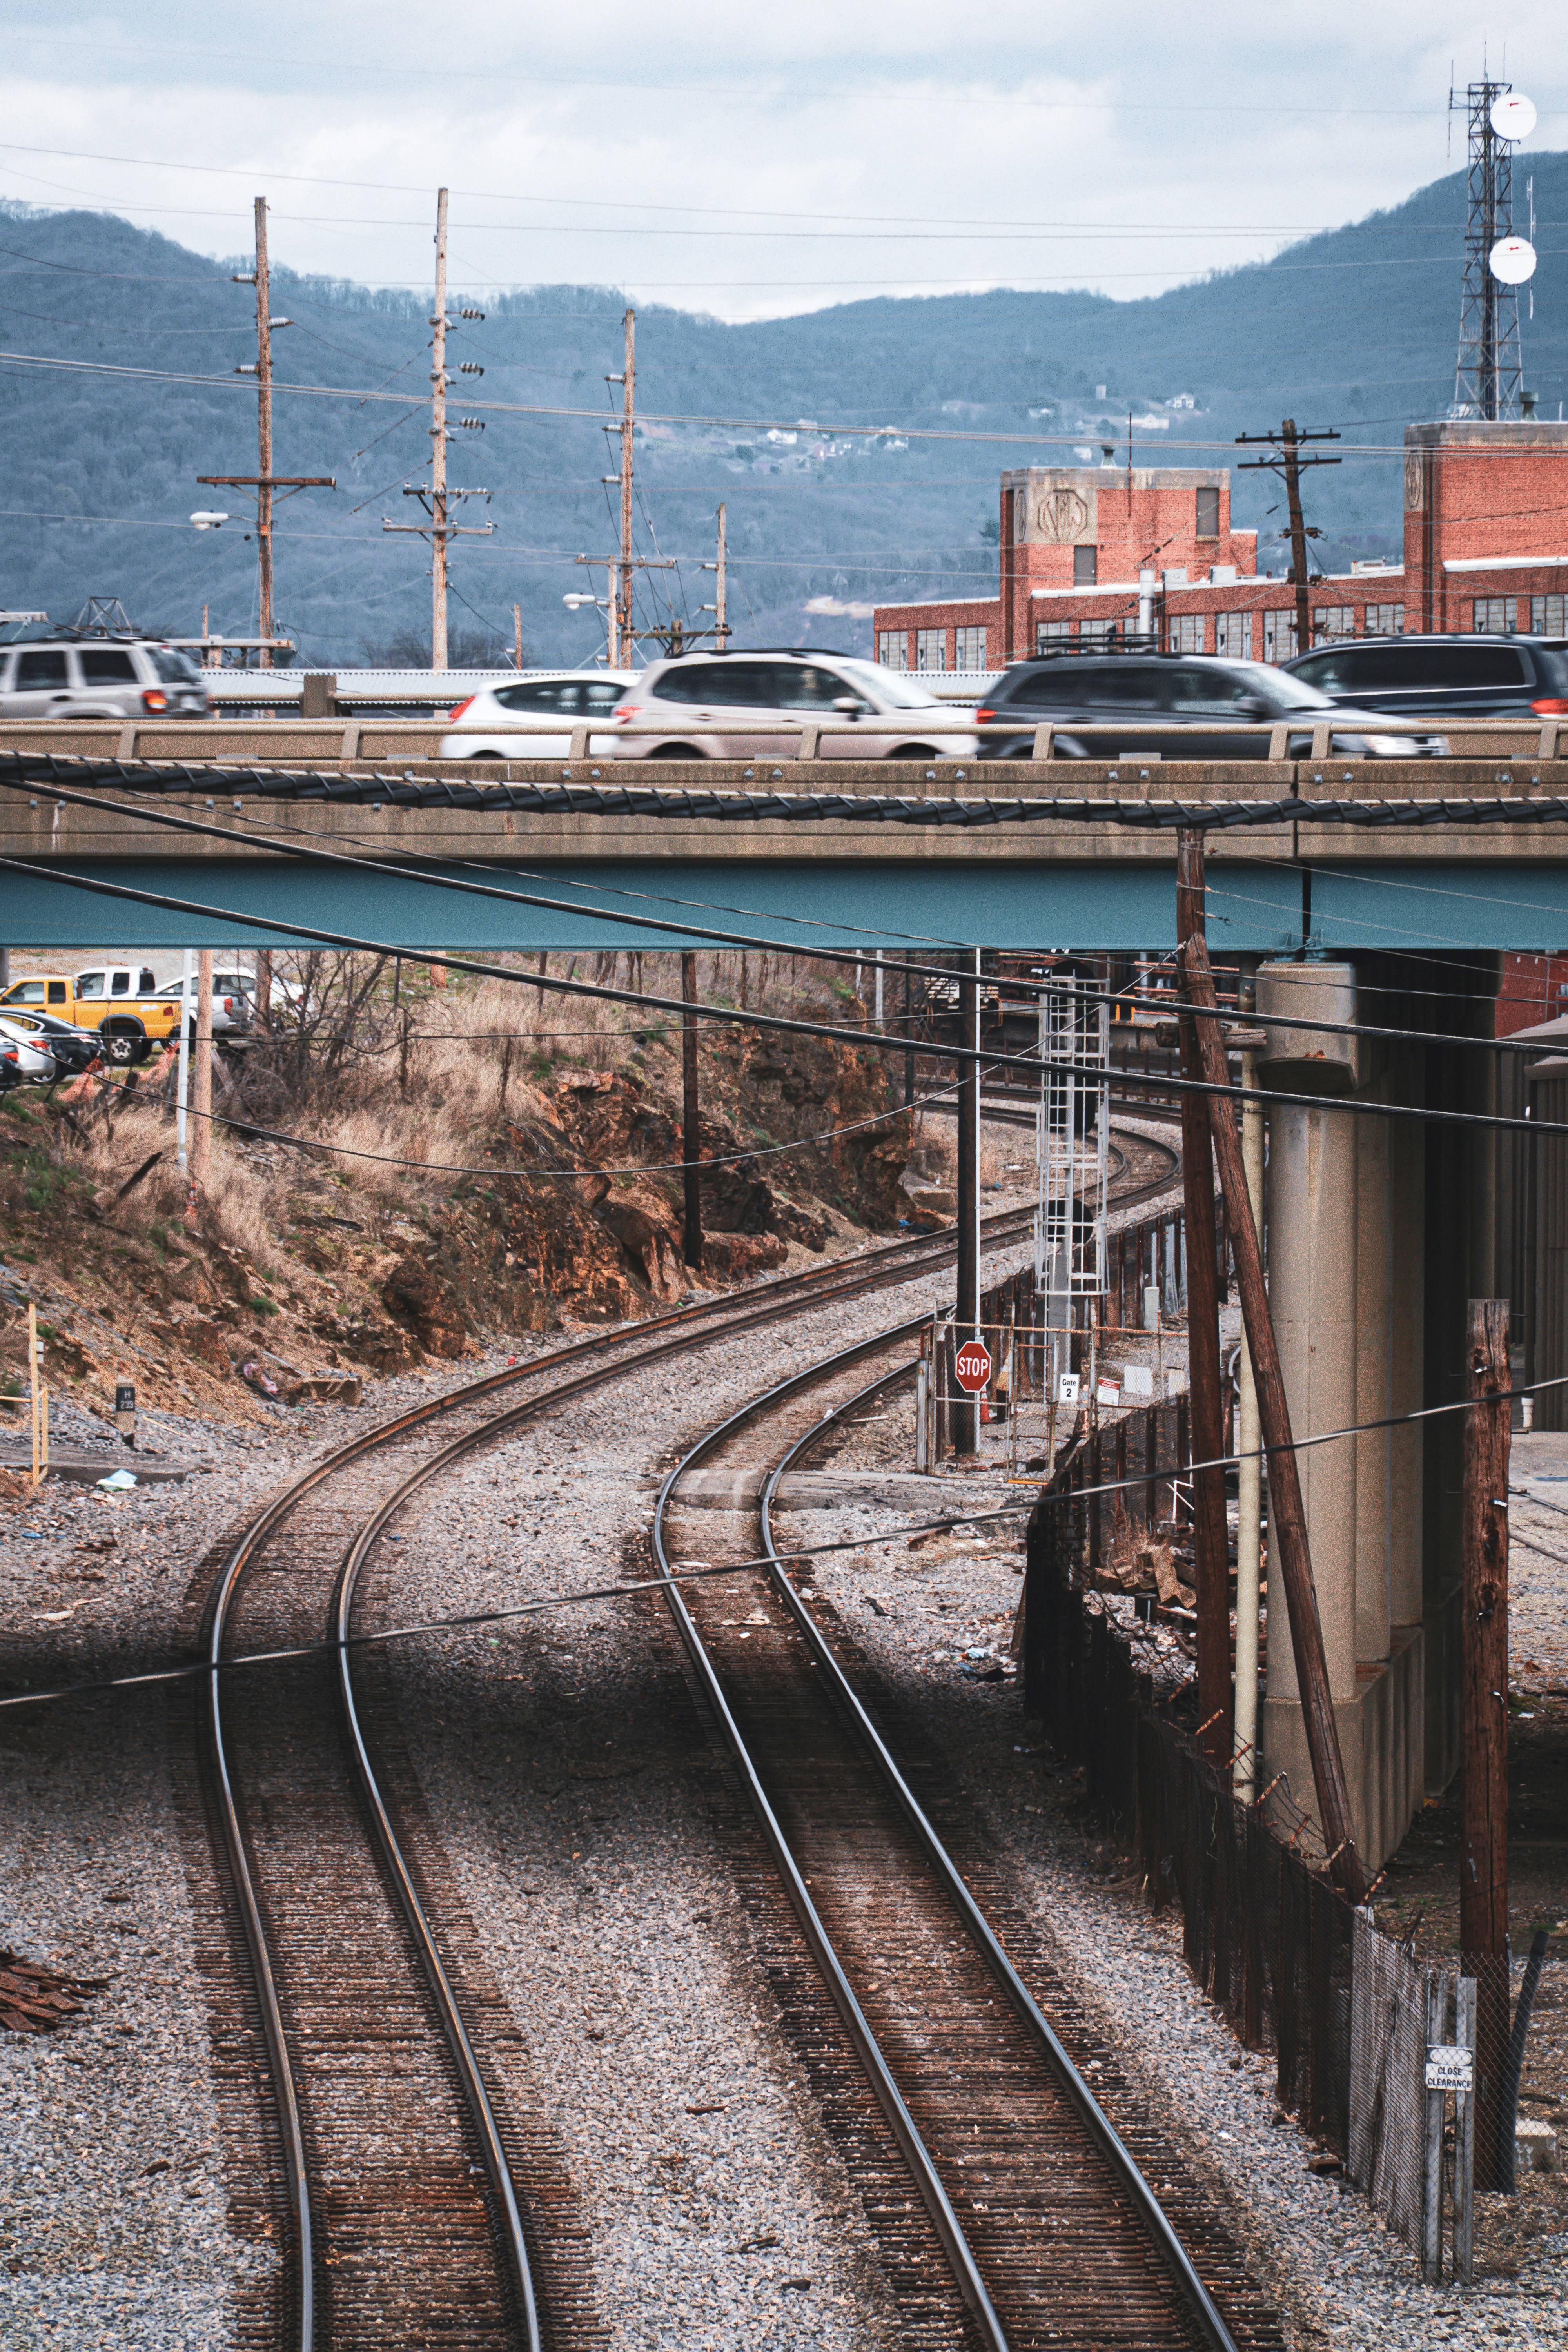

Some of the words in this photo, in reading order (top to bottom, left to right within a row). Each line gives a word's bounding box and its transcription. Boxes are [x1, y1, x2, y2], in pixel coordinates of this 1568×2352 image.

[958, 1357, 988, 1376] STOP
[1066, 1388, 1071, 1397] 2
[1437, 2067, 1462, 2076] CLOSE
[1427, 2078, 1472, 2088] CLEARANCE
